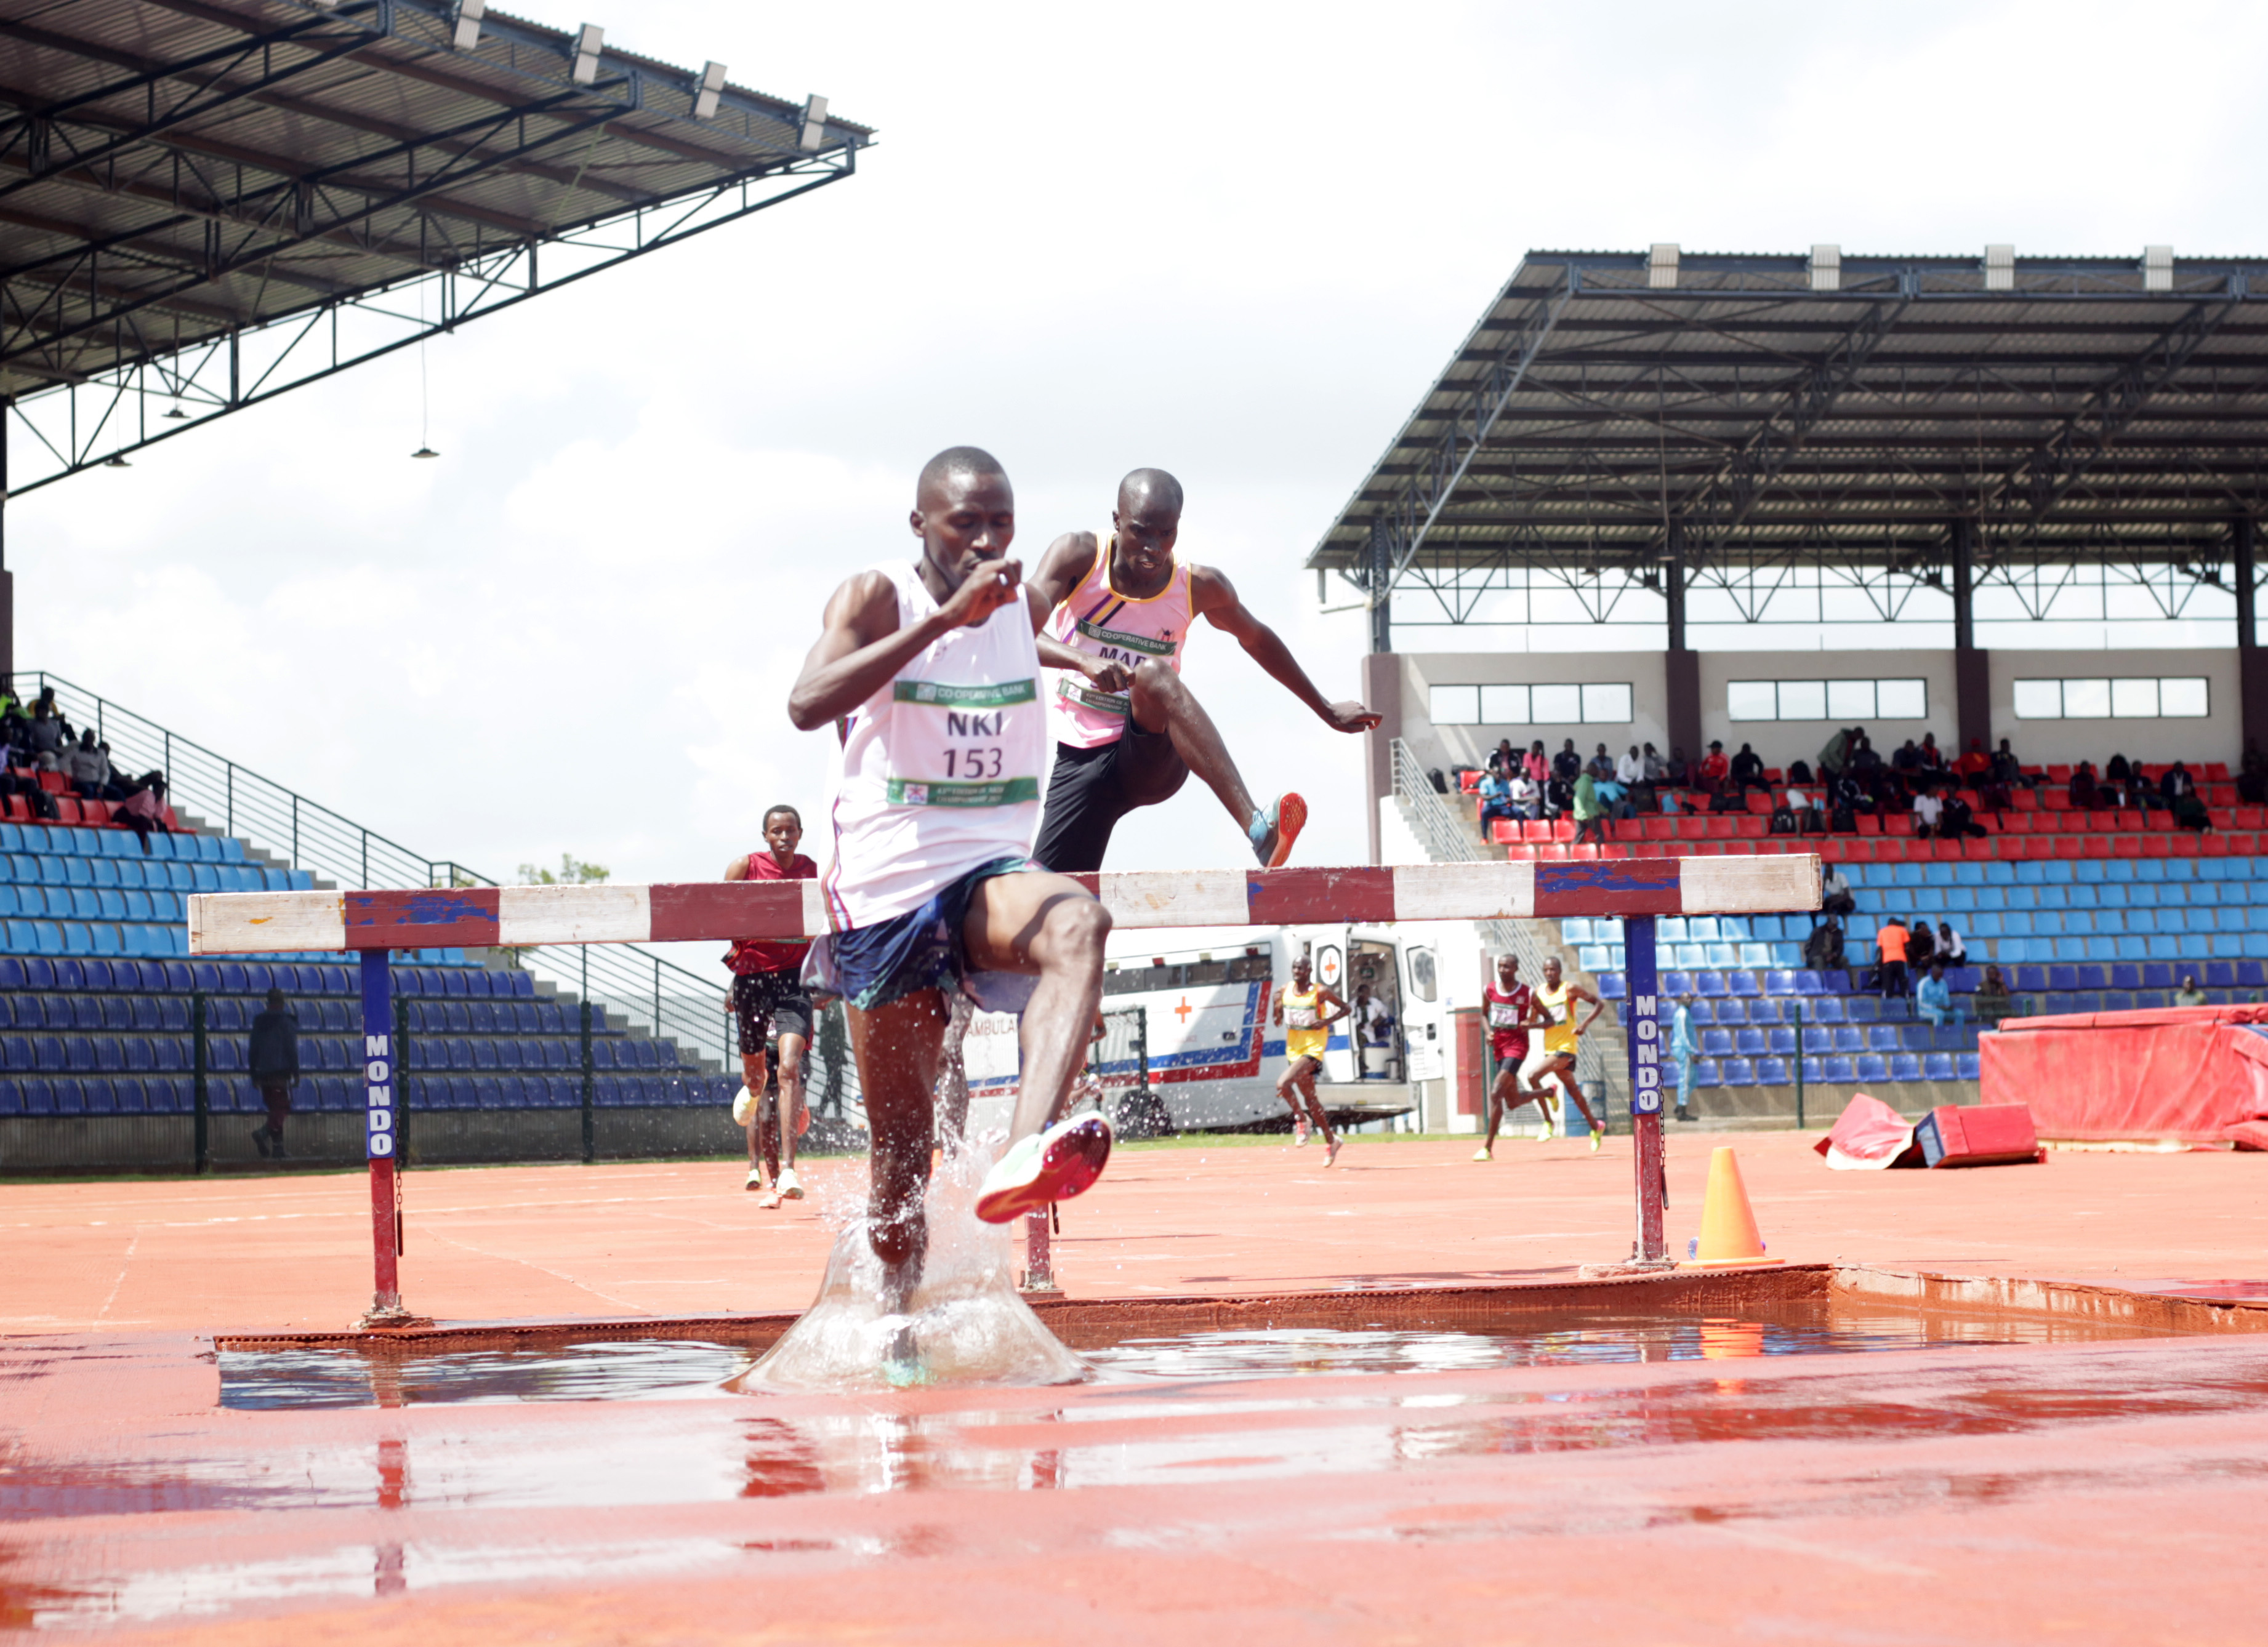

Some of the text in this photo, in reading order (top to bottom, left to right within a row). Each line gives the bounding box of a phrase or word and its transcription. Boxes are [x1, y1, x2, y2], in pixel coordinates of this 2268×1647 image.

[1101, 631, 1167, 650] CO-OPERATIVE BANK
[1002, 684, 1025, 696] BANK
[949, 711, 1002, 735] NKI
[943, 748, 1002, 779] 153
[967, 1019, 1017, 1038] AMBULA
[1636, 995, 1659, 1111] MONDO
[366, 1035, 392, 1155] MONDO
